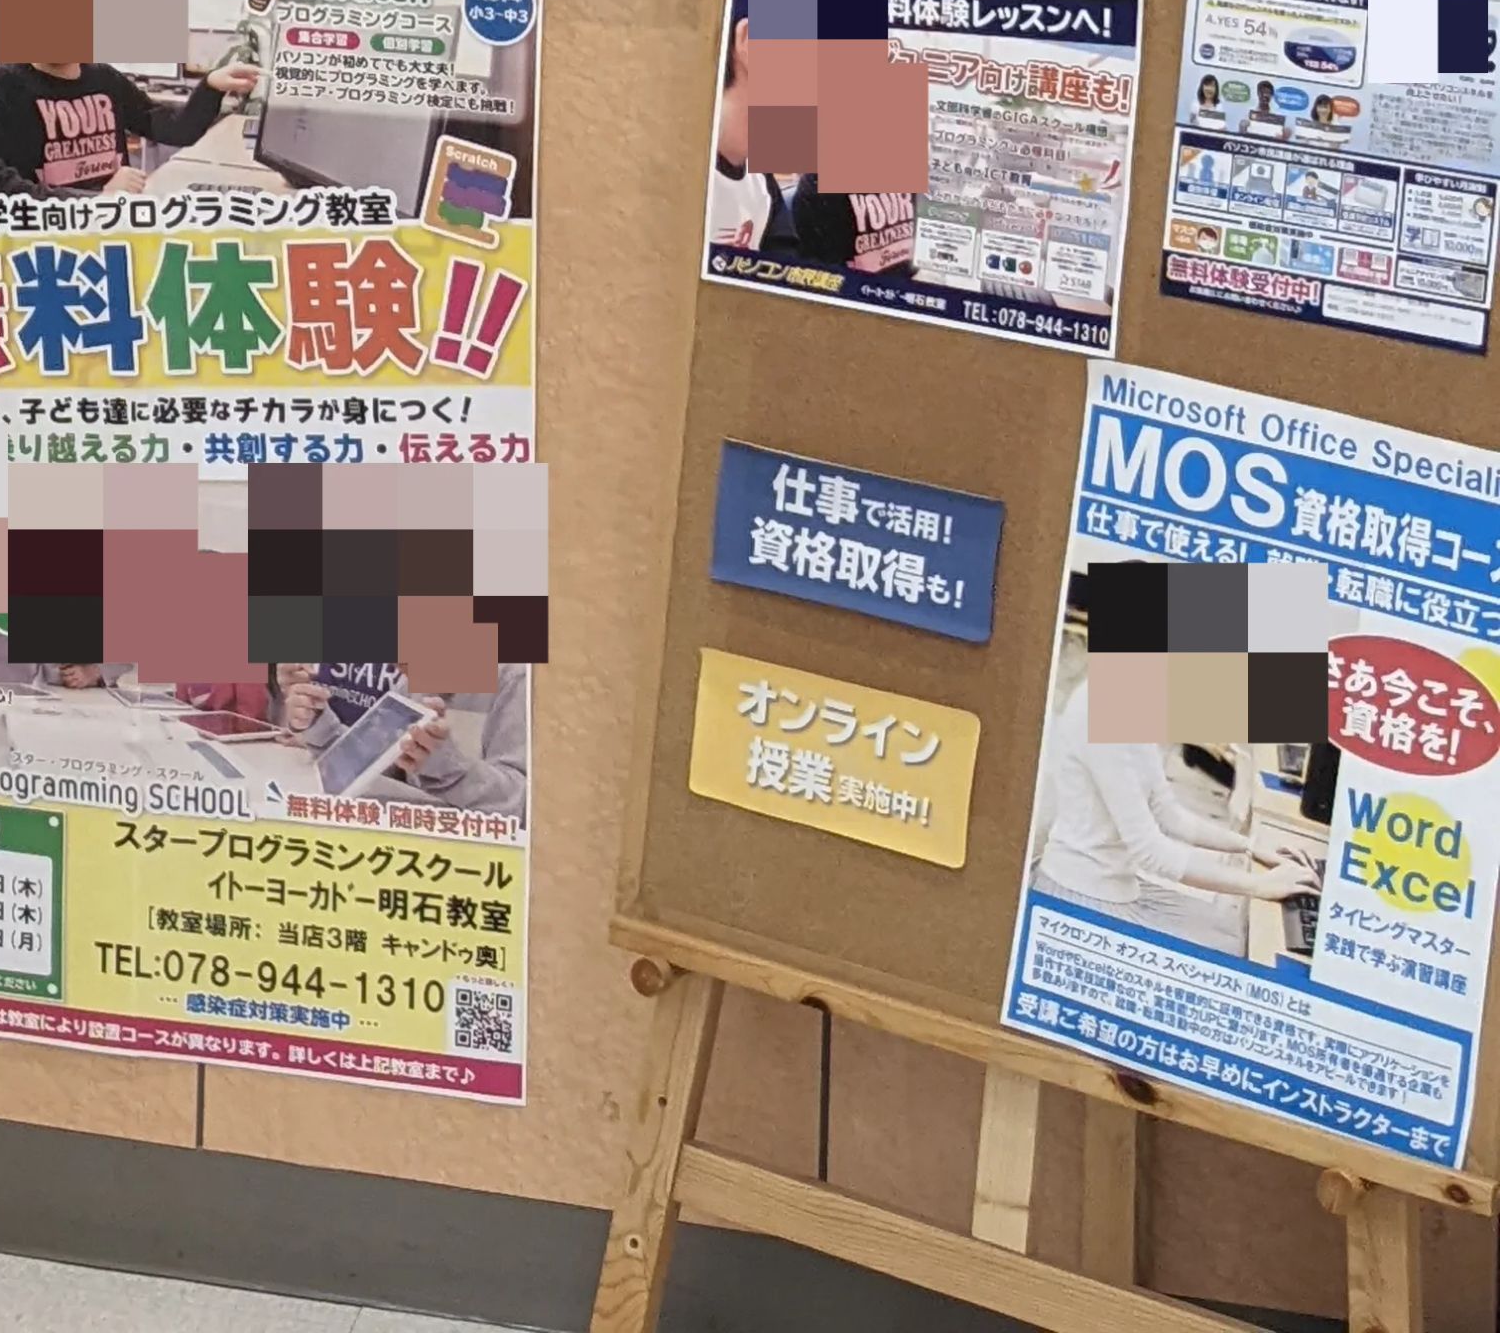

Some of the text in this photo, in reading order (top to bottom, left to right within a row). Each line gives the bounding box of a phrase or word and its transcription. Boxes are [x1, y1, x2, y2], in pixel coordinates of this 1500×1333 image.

[275, 4, 452, 34] プログラミングコース
[36, 93, 116, 139] YOUR
[44, 132, 117, 159] GREATNESS
[445, 145, 501, 172] Scratch
[1169, 255, 1321, 304] 無料体験受付中!
[962, 300, 1109, 346] TEL:078-944-1310
[8, 432, 531, 464] り越える力・共創する力・伝える力
[1102, 374, 1247, 435] Microsoft
[1261, 414, 1358, 461] Office
[772, 463, 954, 545] 仕事で活用!
[1090, 413, 1288, 530] MOS
[748, 516, 965, 609] 資格取得も!
[1086, 496, 1248, 564] 仕事で使える!
[736, 679, 940, 766] オンライン
[1341, 697, 1461, 766] 資格を!
[12, 752, 205, 781] スター・プログラミング・スクール
[745, 736, 931, 827] 授業 実施中!
[149, 783, 251, 818] SCHOOL
[287, 793, 517, 842] 無料体験 随時受付中!
[1346, 786, 1462, 859] Word
[113, 820, 514, 891] スタープログラミングスクール
[1339, 840, 1477, 920] Excel
[208, 870, 513, 935] イトーヨーカドー明石教室
[1329, 901, 1471, 958] タイピングマスター
[277, 921, 368, 955] 当店3階
[1038, 914, 1112, 950] マイクロソフト
[1116, 941, 1158, 966] オフィス
[1164, 955, 1243, 993] スペシャリスト
[1287, 995, 1312, 1017] とは
[1325, 932, 1469, 996] 実践で学ぶ演習講座
[94, 940, 446, 1014] TEL:078-944-1310
[185, 992, 351, 1031] 感染症対策実施中
[1016, 991, 1451, 1158] 受講ご希望の方はお早めにインストラクターまで
